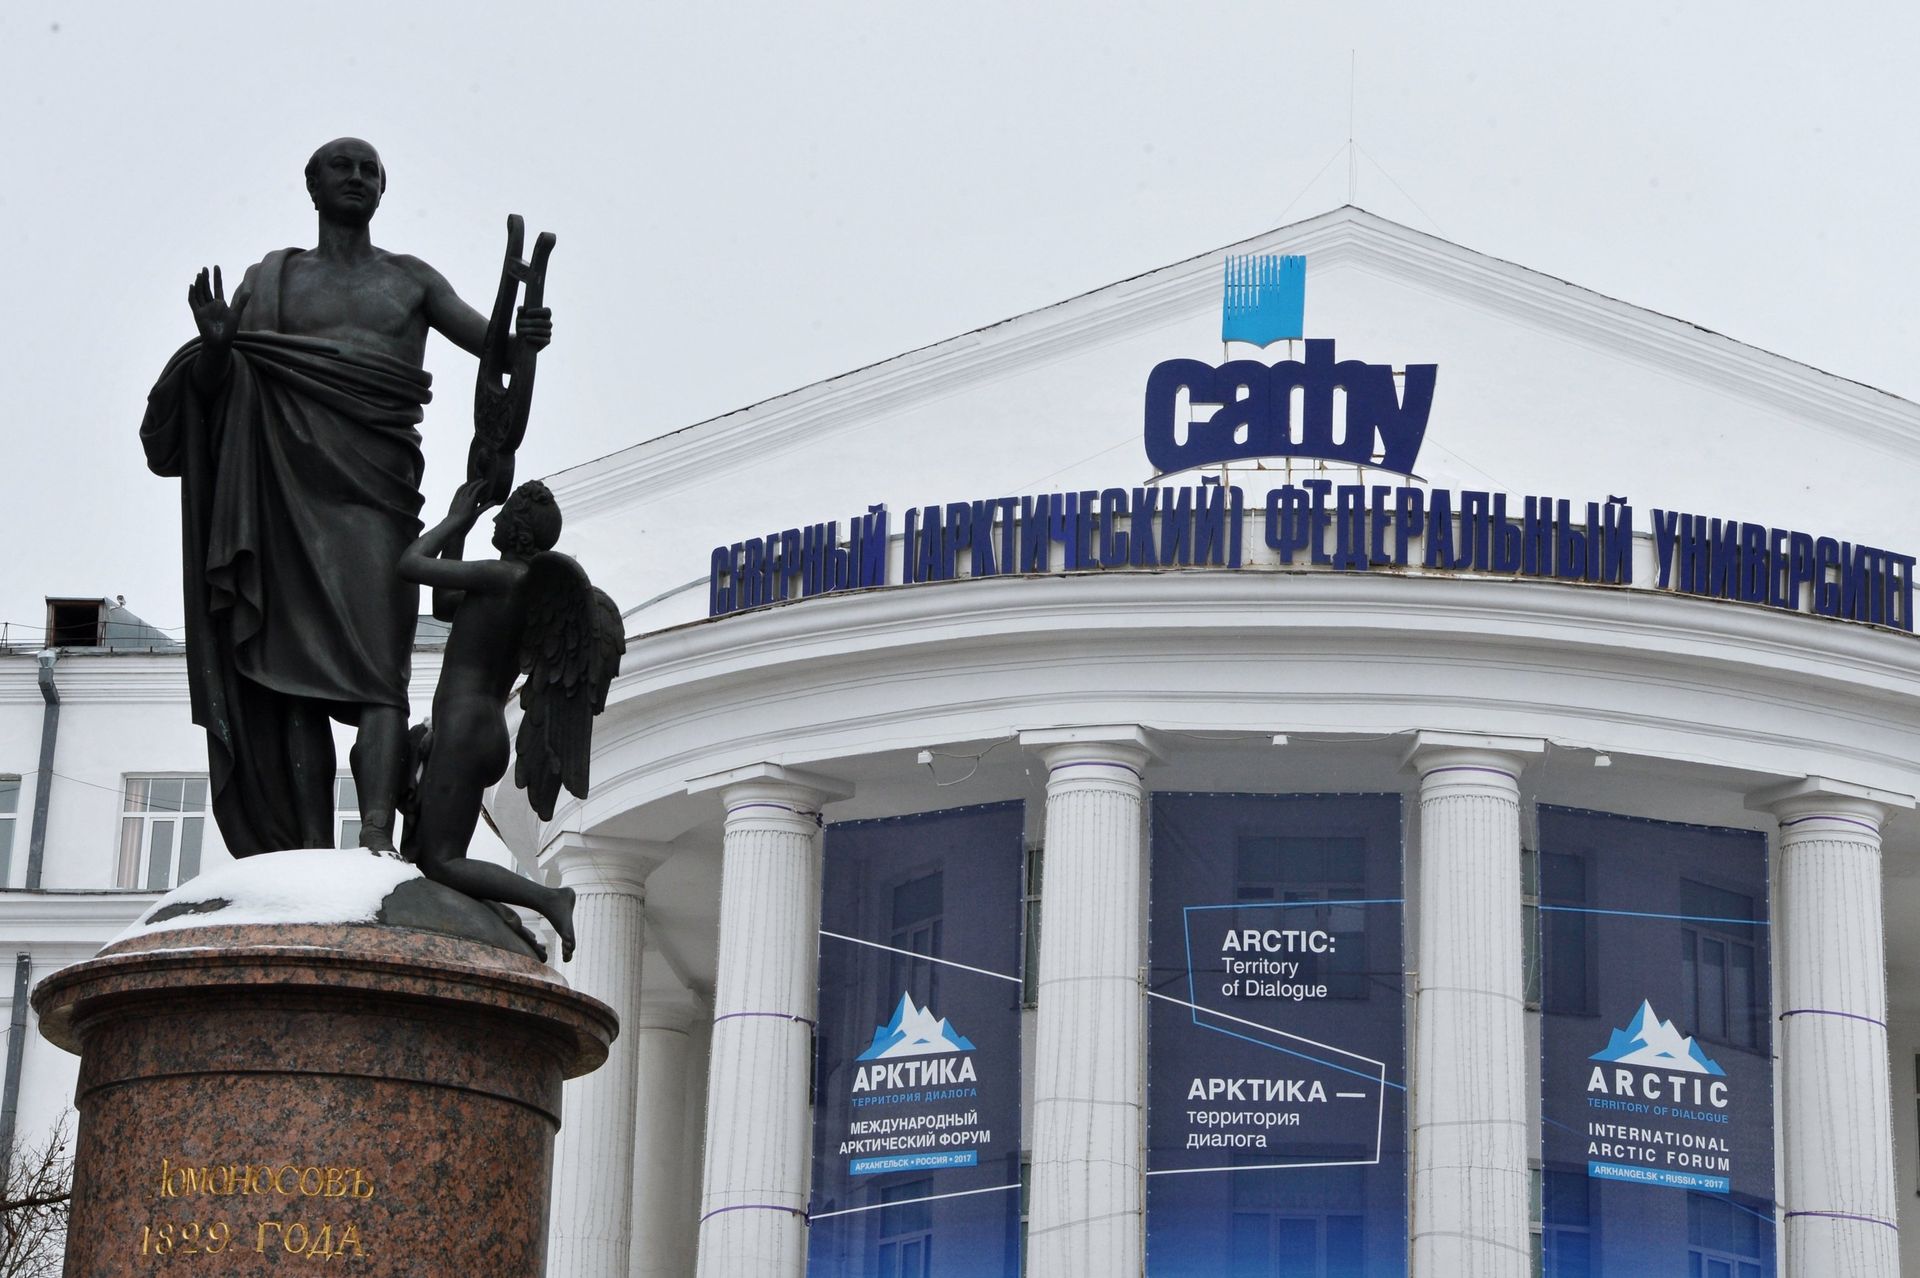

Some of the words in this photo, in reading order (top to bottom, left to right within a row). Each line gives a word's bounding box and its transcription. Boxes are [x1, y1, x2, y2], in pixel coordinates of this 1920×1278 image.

[709, 502, 889, 618] СЕВЕРНЫЙ
[1265, 479, 1633, 586] ФЕДЕРАЛЬНЫЙ
[1650, 508, 1917, 633] УНИВЕРСИТЕТ
[1221, 929, 1336, 953] ARCTIC:
[1221, 957, 1299, 979] Territory
[1221, 979, 1240, 997] of
[1245, 979, 1328, 1002] Dialogue
[852, 1056, 977, 1093] АРКТИКА
[851, 1091, 922, 1108] ТЕРРИТОРИЯ
[924, 1087, 978, 1103] ДИАЛОГА
[1187, 1078, 1328, 1103] АРКТИКА
[1587, 1066, 1729, 1109] ARCTIC
[850, 1109, 978, 1136] МЕЖДУНАРОДНЫЙ
[1187, 1110, 1300, 1129] территория
[1587, 1097, 1650, 1114] TERRITORY
[1653, 1105, 1669, 1117] OF
[1671, 1108, 1729, 1125] DIALOGUE
[839, 1131, 936, 1155] АРКТИЧЕСКИЙ
[938, 1129, 991, 1147] ФОРУМ
[1186, 1132, 1268, 1150] диалога
[1588, 1122, 1730, 1153] INTERNATIONAL
[855, 1158, 910, 1172] АРХАНГЕЛЬСК
[915, 1155, 948, 1167] РОССИЯ
[954, 1154, 972, 1164] 2017
[1588, 1141, 1657, 1162] ARCTIC
[1666, 1151, 1731, 1172] FORUM
[1594, 1165, 1659, 1182] ARKHANGELSK
[1665, 1174, 1697, 1187] RUSSIA
[1704, 1179, 1724, 1190] 2017
